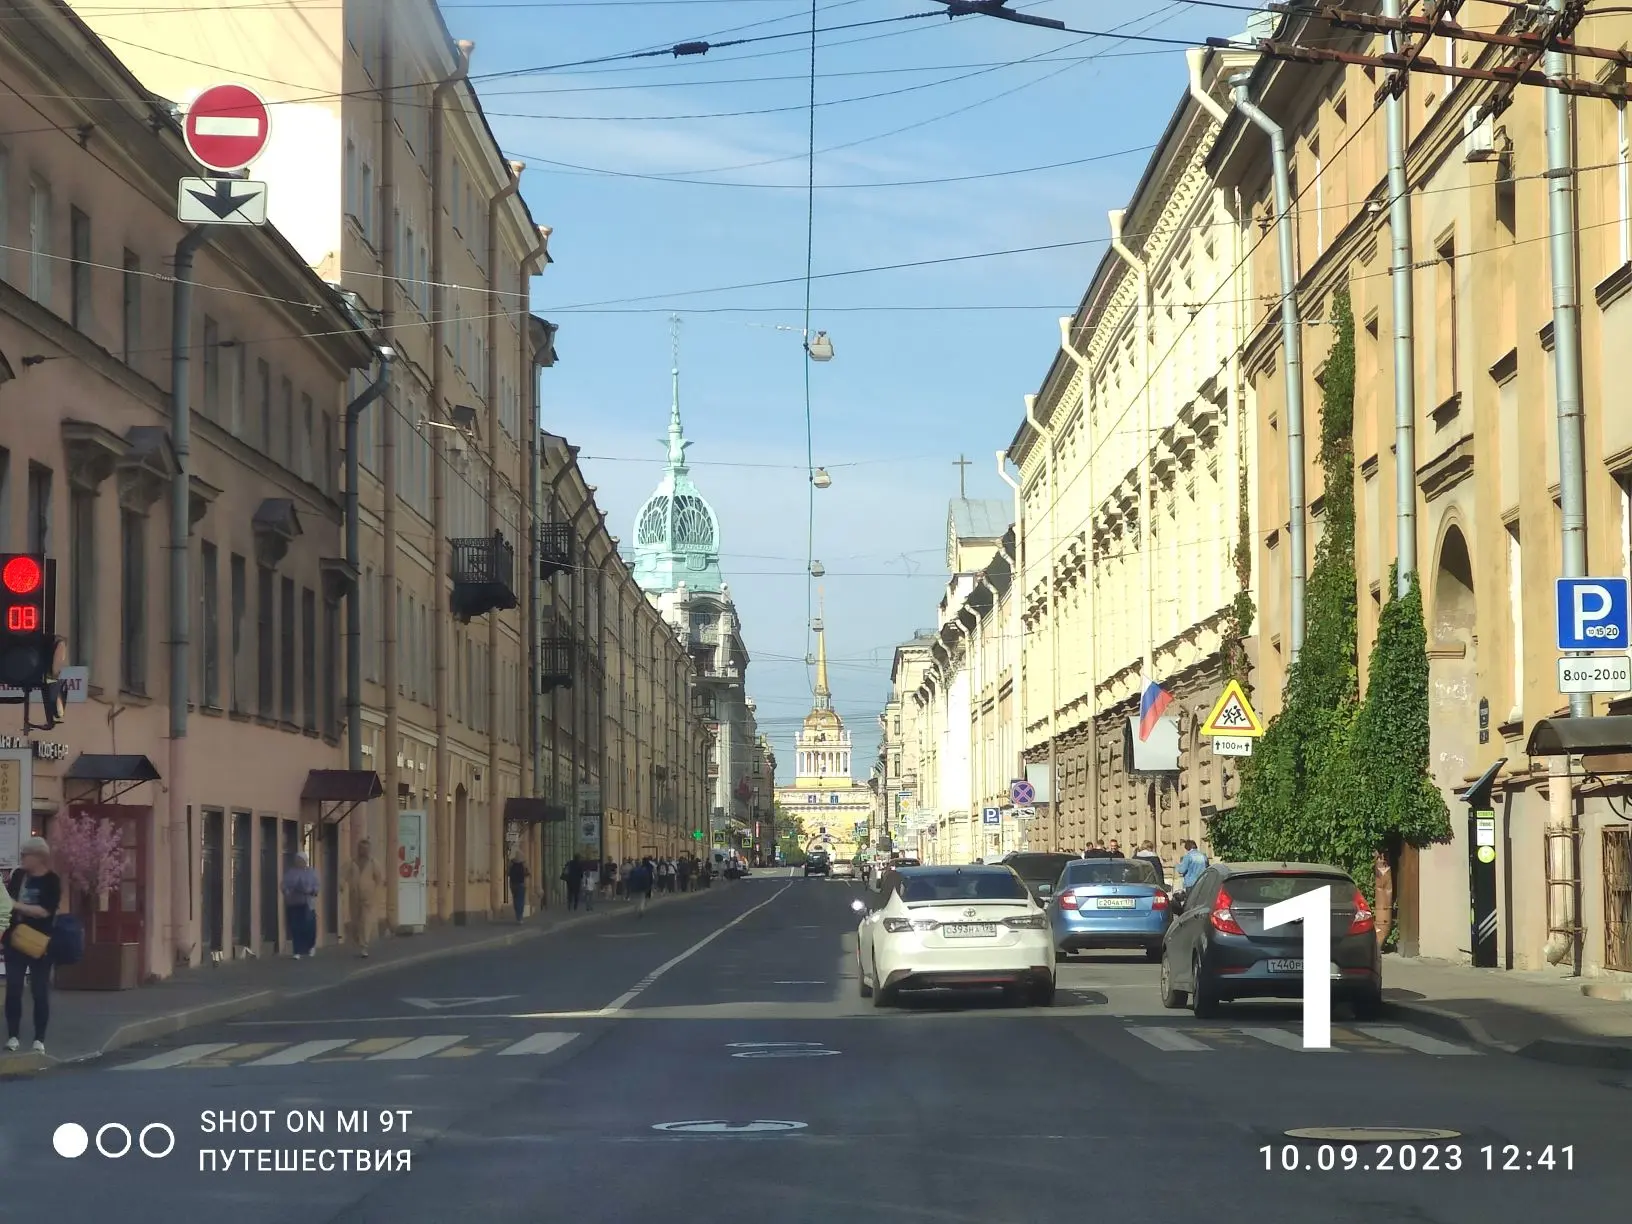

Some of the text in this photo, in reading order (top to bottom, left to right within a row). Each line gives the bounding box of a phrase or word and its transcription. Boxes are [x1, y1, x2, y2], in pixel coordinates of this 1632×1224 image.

[9, 605, 36, 630] 08
[1573, 584, 1612, 640] P
[1607, 627, 1618, 636] 20
[1563, 669, 1626, 681] 8.00-20.00
